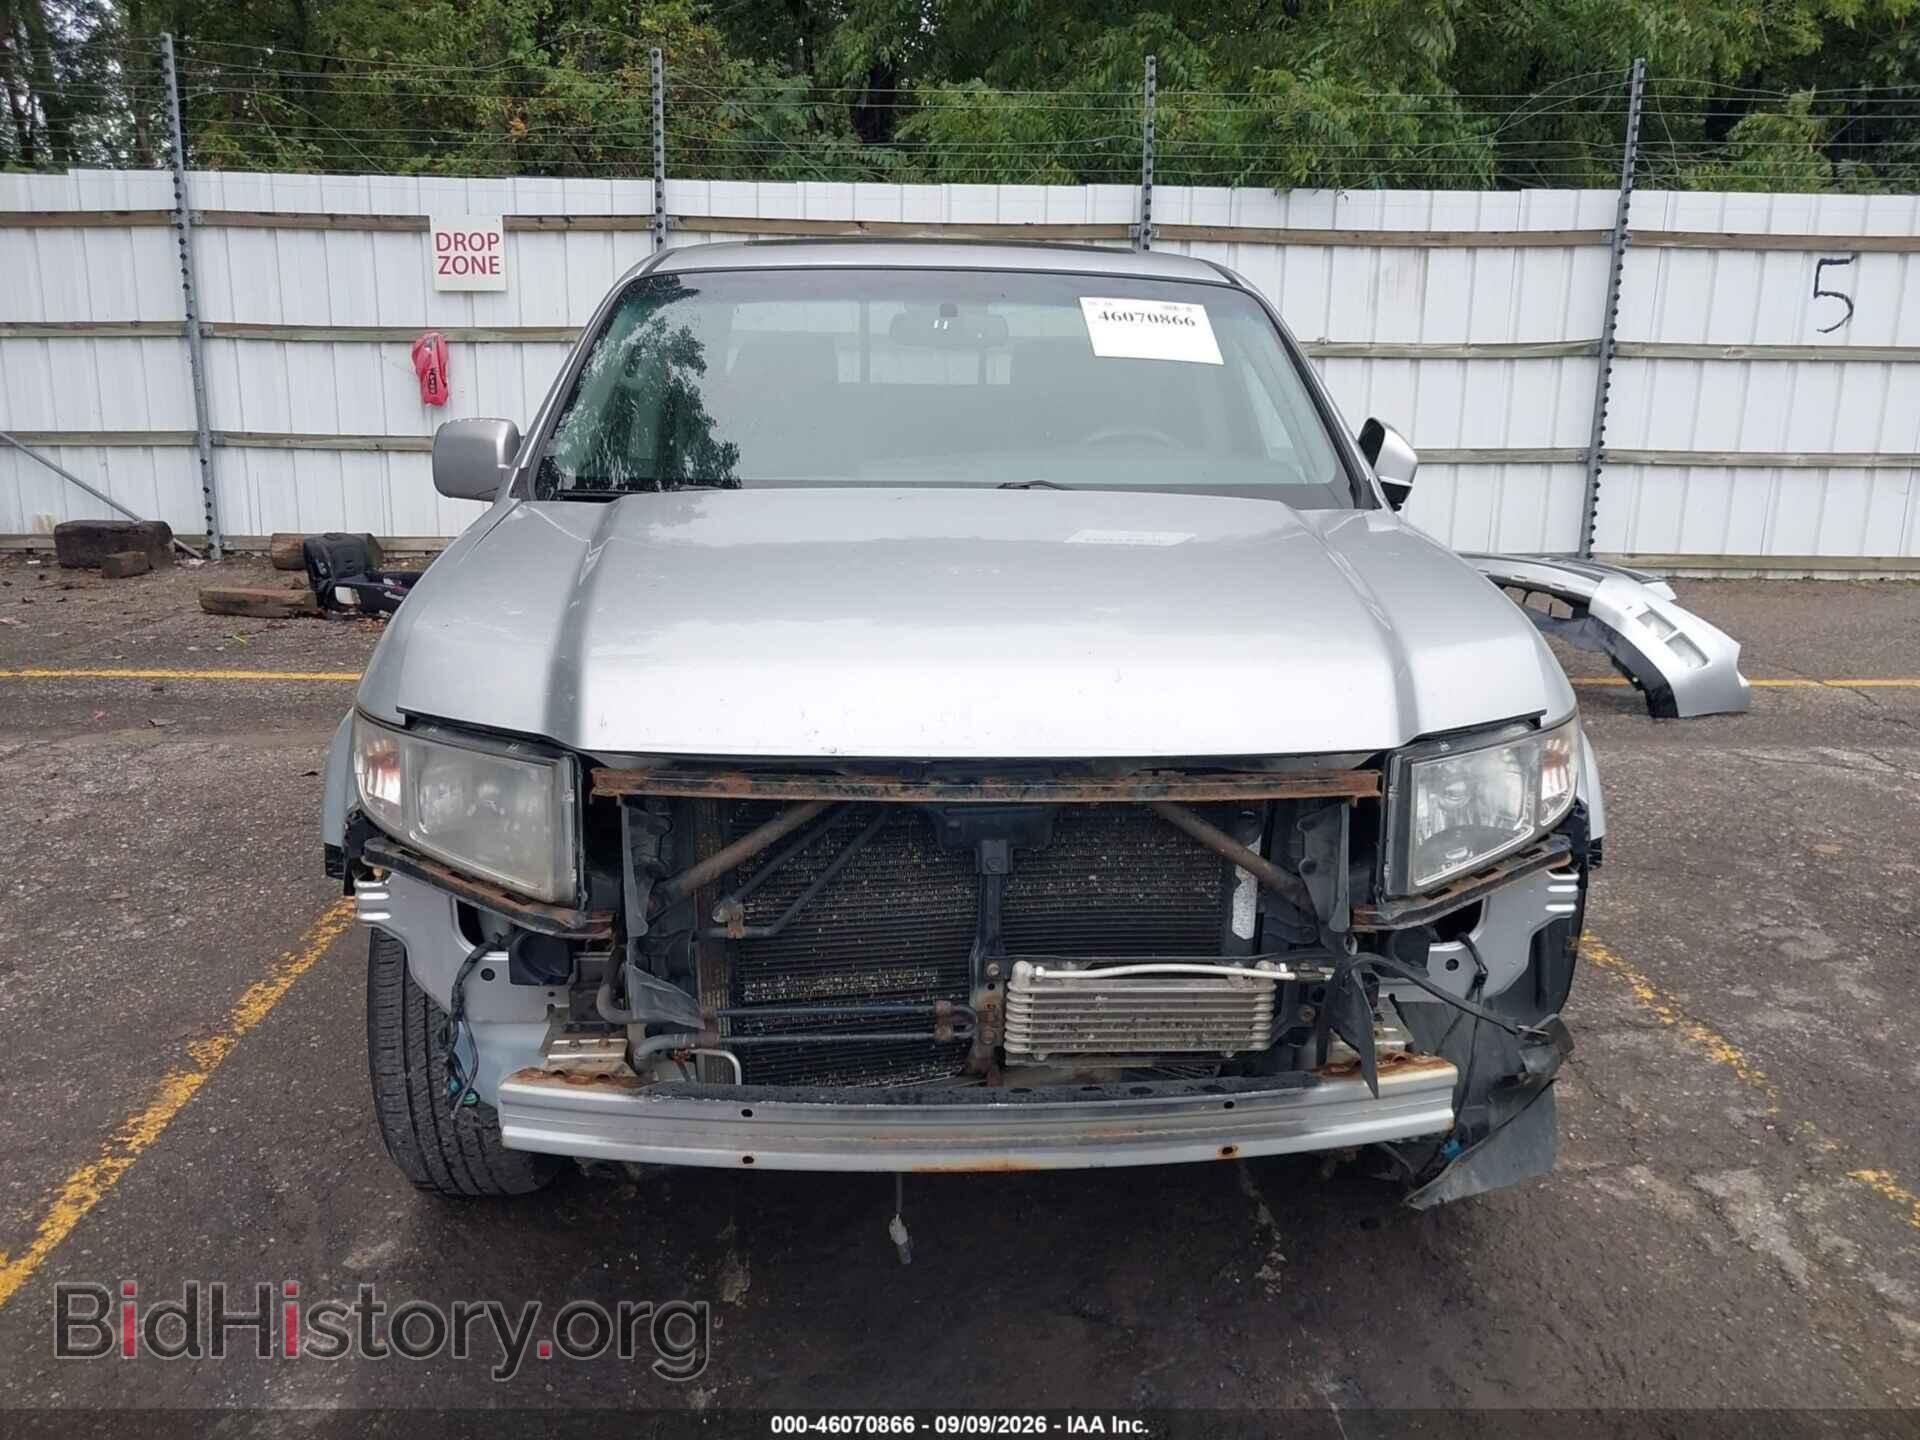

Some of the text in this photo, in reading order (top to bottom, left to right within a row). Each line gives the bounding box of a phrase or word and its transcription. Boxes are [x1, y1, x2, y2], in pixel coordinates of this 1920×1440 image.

[435, 232, 500, 252] DROP
[437, 255, 501, 275] ZONE
[1813, 255, 1856, 333] 5
[1098, 310, 1196, 327] 46070866
